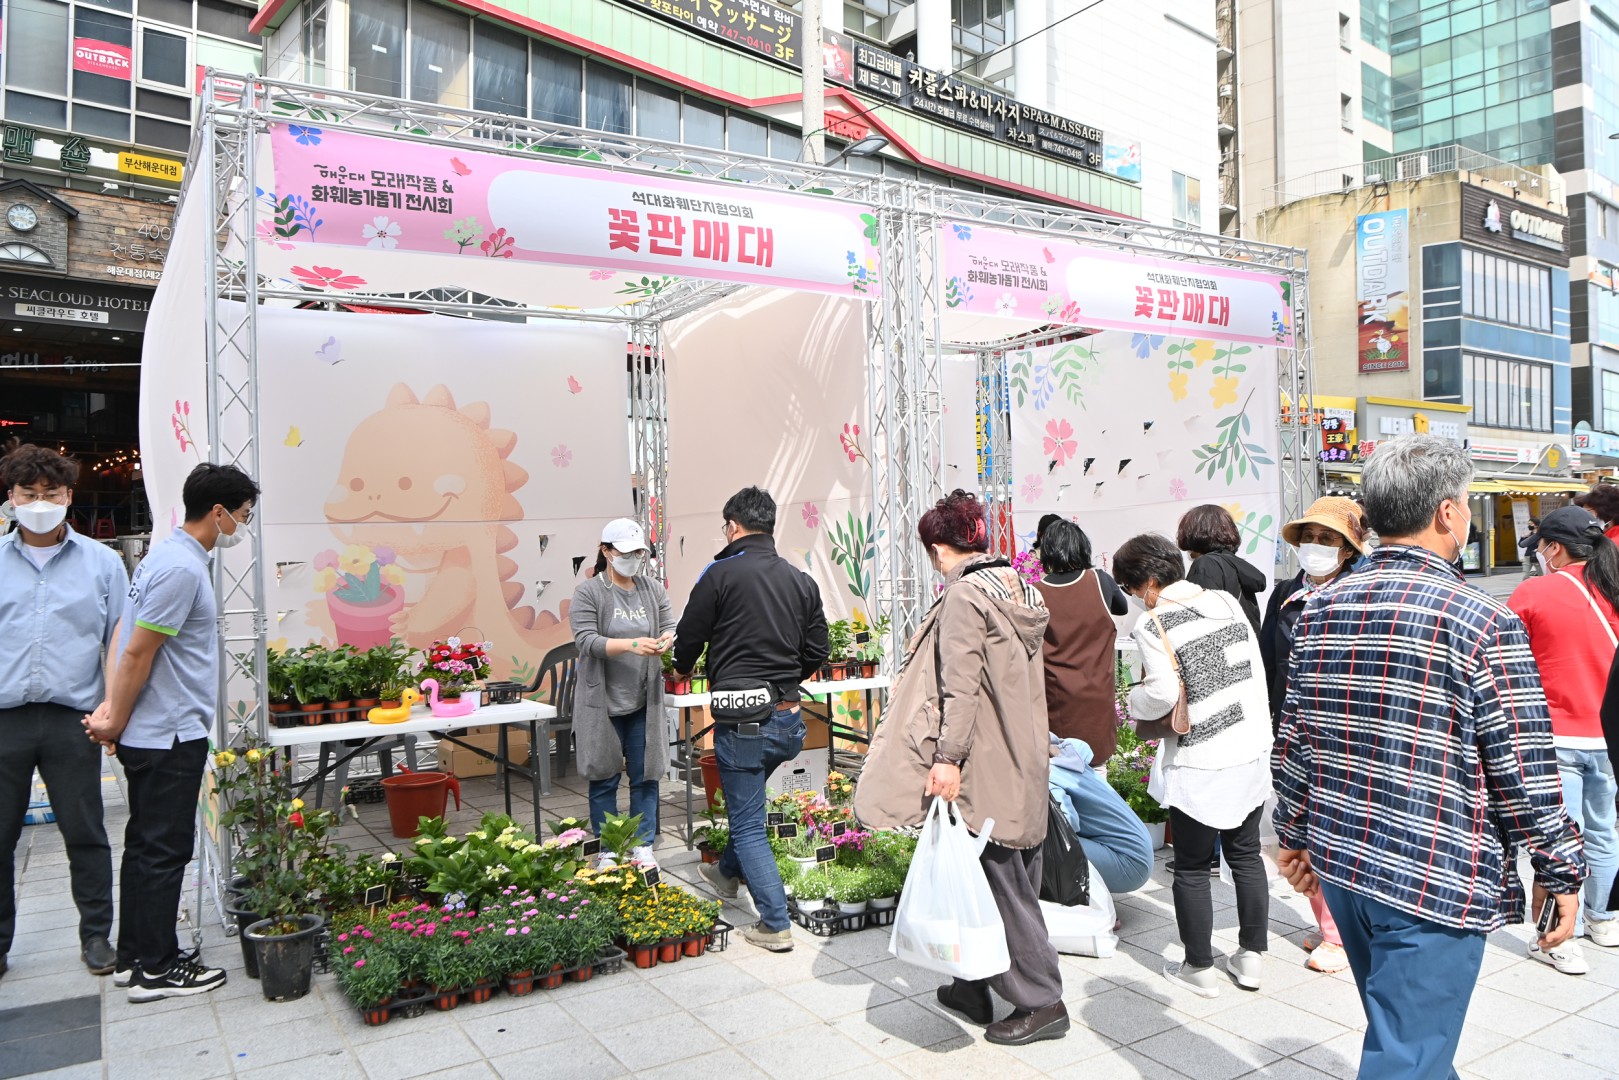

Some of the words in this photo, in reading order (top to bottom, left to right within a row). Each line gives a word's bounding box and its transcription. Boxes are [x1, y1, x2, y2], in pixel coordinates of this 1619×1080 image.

[773, 9, 794, 28] 완비
[696, 14, 719, 34] 예약
[720, 24, 772, 53] 747-0410
[774, 43, 795, 61] 3F
[75, 50, 129, 68] OUTBACK
[858, 47, 902, 78] 최고급버블
[858, 68, 902, 97] 제트스파
[908, 68, 1020, 126] 커플스파&마사지
[913, 96, 937, 112] 24시간
[124, 157, 178, 176] 부산해운대점
[1088, 152, 1102, 166] 3F
[313, 164, 365, 185] 해운대
[370, 170, 437, 193] 모래작품
[442, 179, 454, 195] &
[311, 184, 402, 210] 화훼농가돕기
[405, 193, 453, 215] 전시회
[631, 191, 754, 220] 석대화훼단지협의회
[137, 223, 176, 241] 400
[106, 265, 163, 281] 해운대점(제2
[968, 255, 999, 270] 해운대
[1001, 259, 1038, 276] 모래작품
[1362, 217, 1389, 325] OUTDARK
[967, 269, 1020, 289] 화훼농가돕기
[1021, 275, 1048, 292] 전시회
[1146, 271, 1218, 291] 석대화훼단지협의회
[8, 286, 94, 306] SEACLOUD
[97, 296, 150, 312] HOTEL
[26, 304, 76, 319] 씨클라우드
[80, 311, 99, 322] 호텔
[1362, 361, 1387, 370] SINCE
[1326, 433, 1344, 444] 王家
[613, 606, 647, 622] PARIS
[711, 691, 767, 710] adidas
